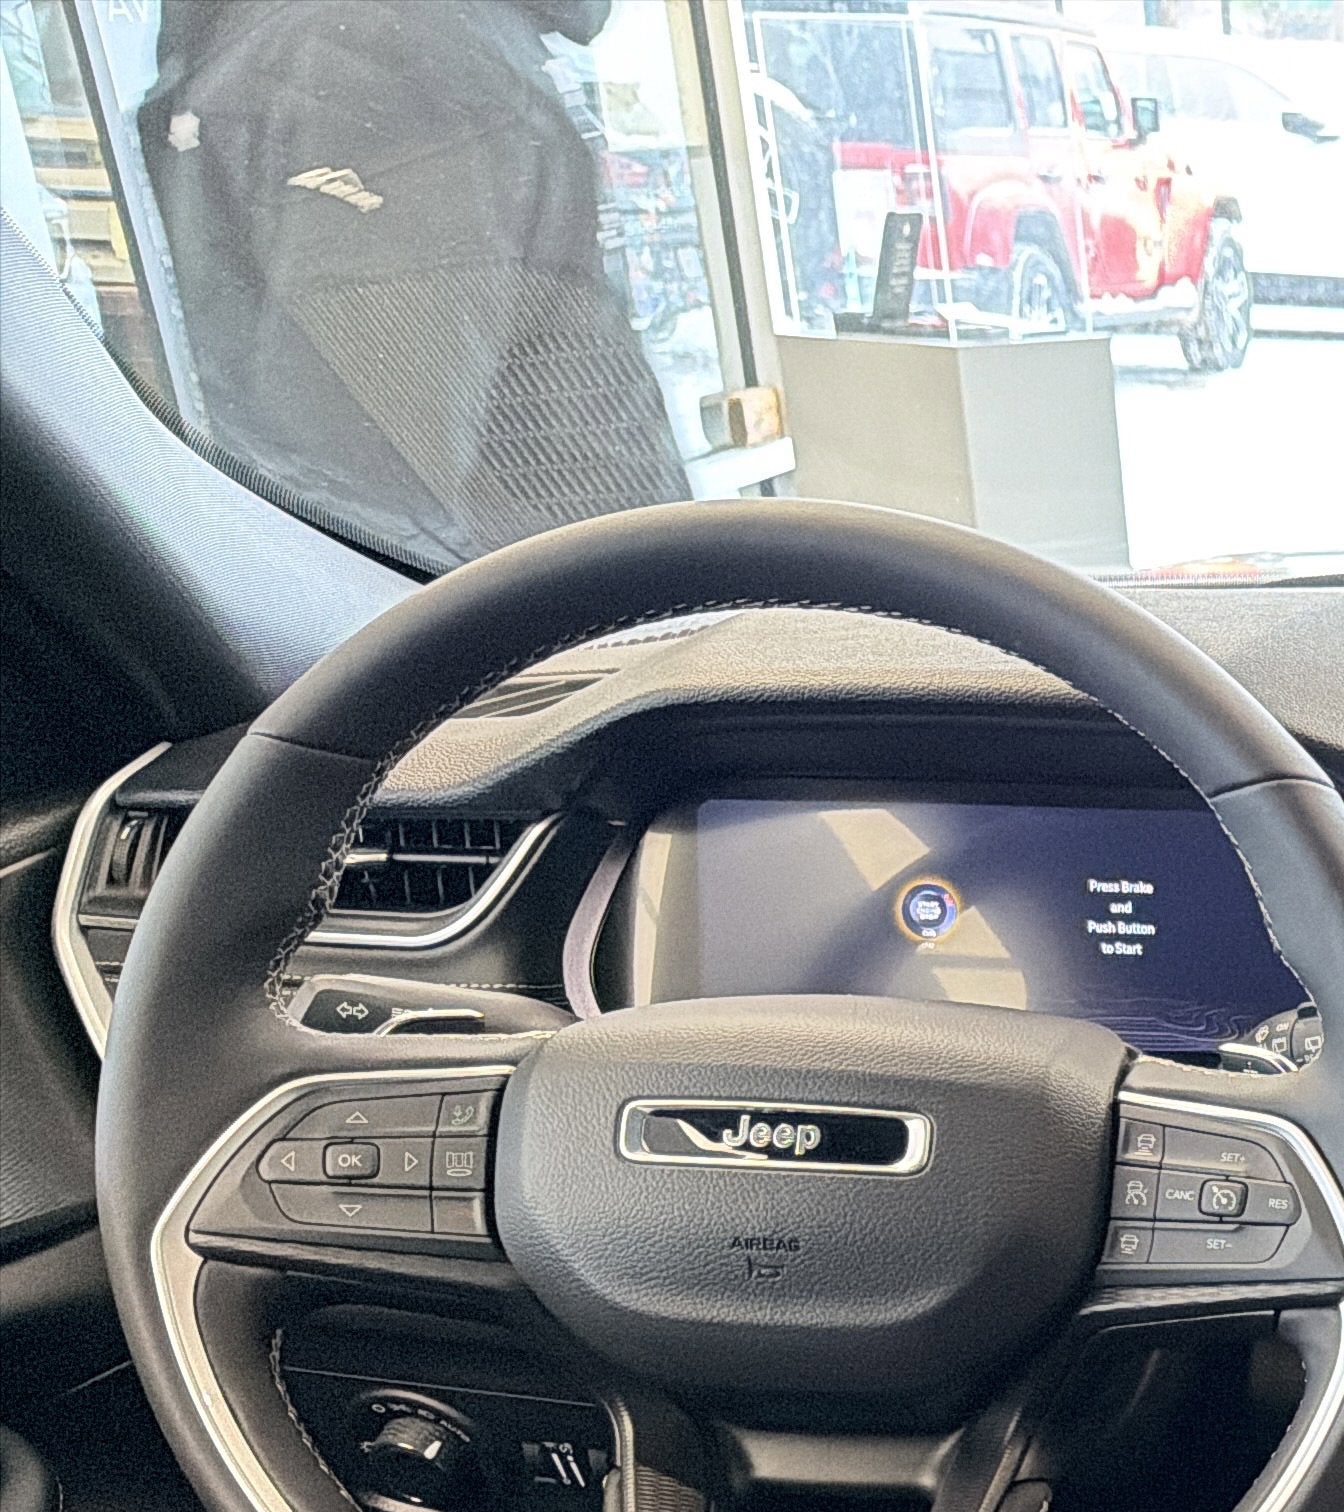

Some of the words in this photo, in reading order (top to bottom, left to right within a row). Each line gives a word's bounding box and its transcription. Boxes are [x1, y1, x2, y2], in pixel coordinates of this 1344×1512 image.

[1087, 878, 1120, 893] Press
[1120, 879, 1155, 895] Brake
[1109, 900, 1133, 914] and
[1087, 919, 1117, 934] Push
[1117, 920, 1156, 936] Button
[1100, 941, 1115, 955] to
[1114, 941, 1144, 956] Start
[722, 1114, 821, 1156] Jeep
[338, 1154, 362, 1167] OK
[1219, 1151, 1246, 1163] SET+
[1165, 1188, 1195, 1201] CANC
[1268, 1197, 1289, 1210] RES
[730, 1235, 801, 1252] AIRBAG
